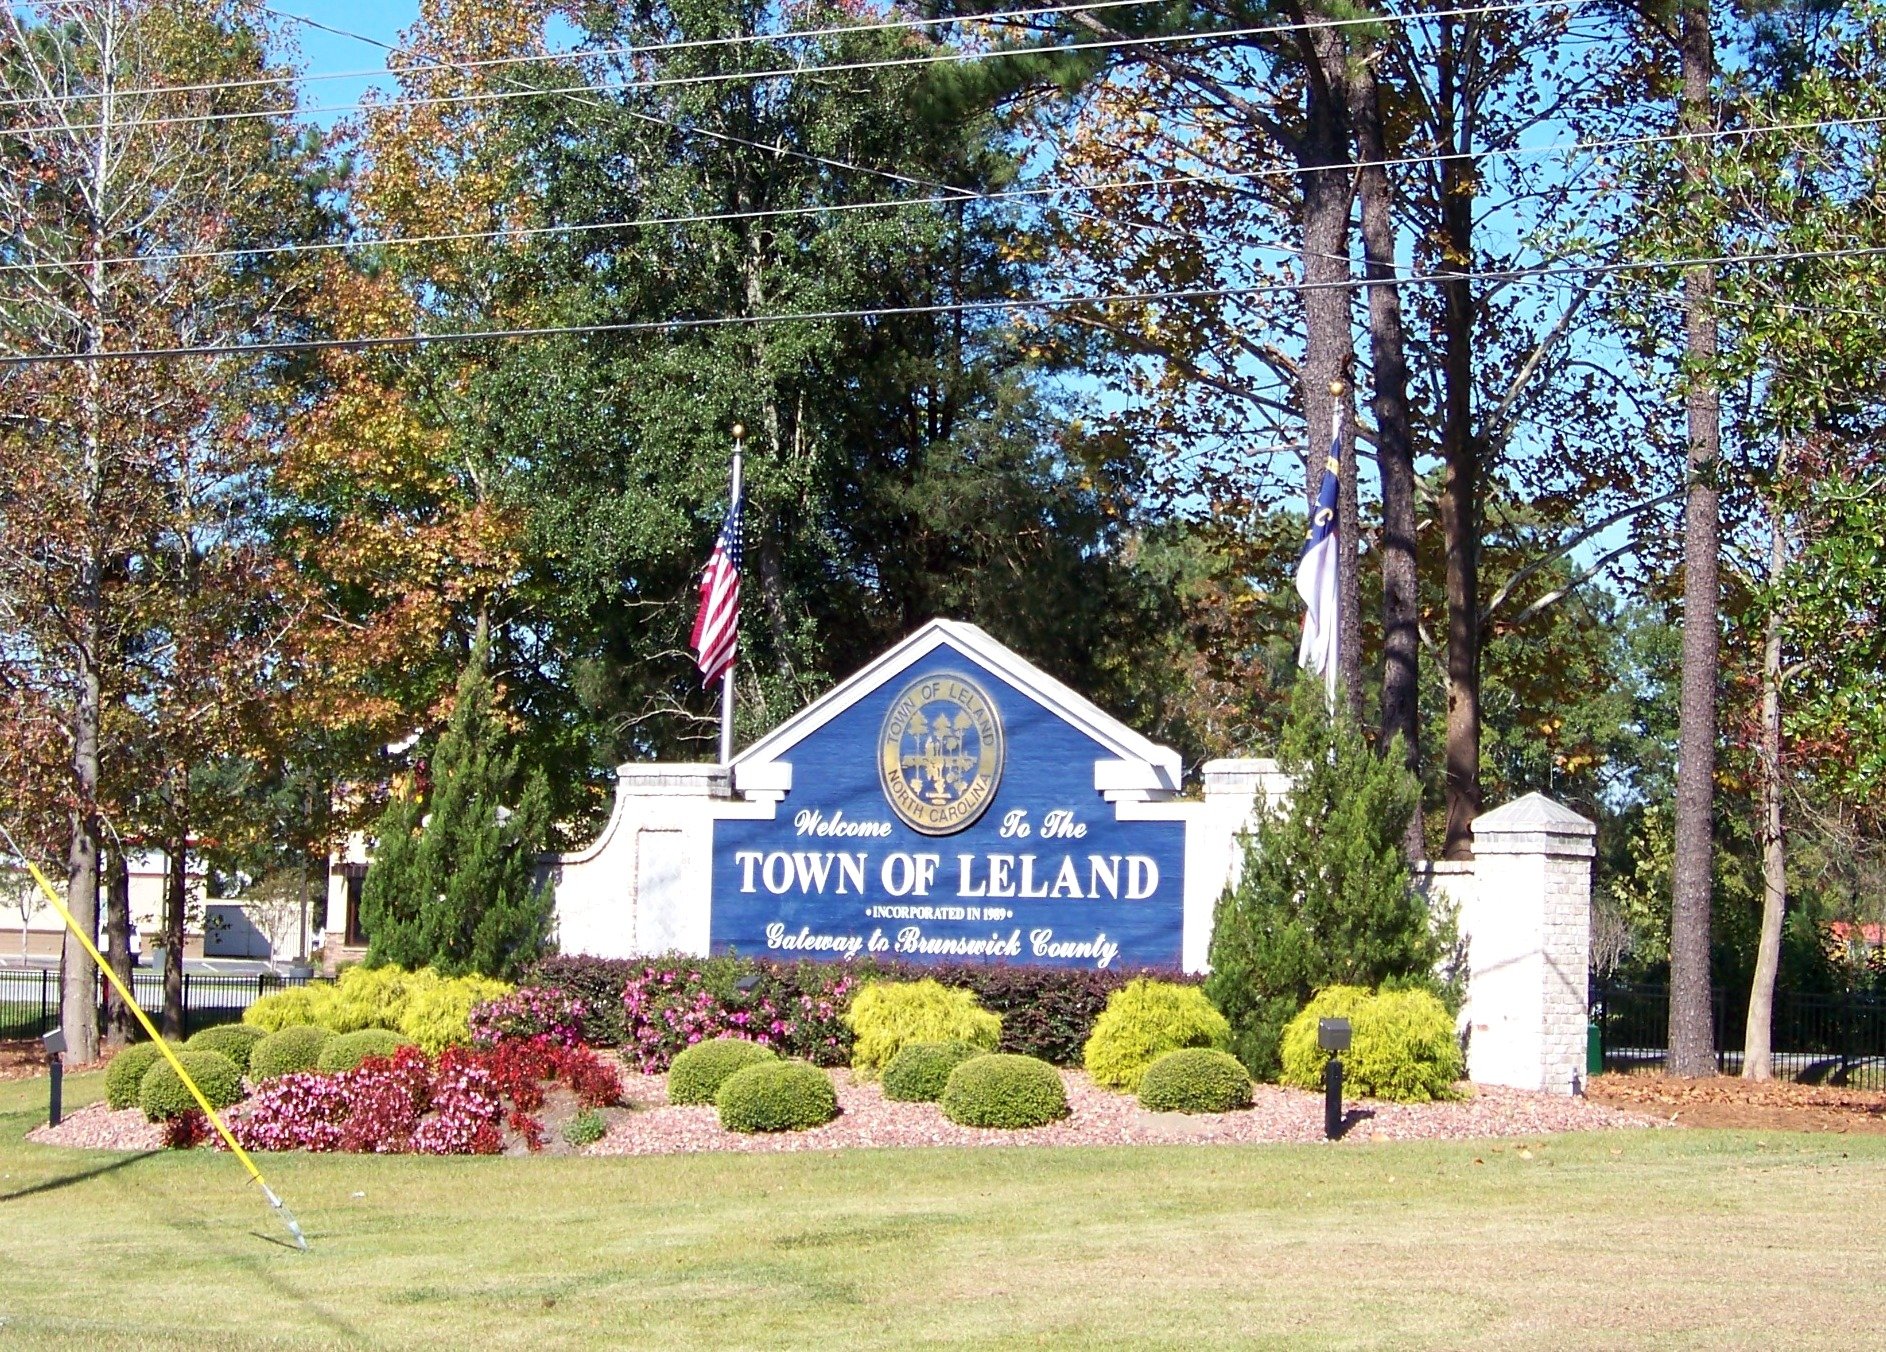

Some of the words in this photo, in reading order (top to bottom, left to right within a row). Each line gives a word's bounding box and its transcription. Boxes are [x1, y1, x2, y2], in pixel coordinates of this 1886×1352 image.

[887, 697, 916, 745] TOWN
[921, 682, 941, 700] OF
[949, 683, 995, 747] LELAND
[888, 769, 924, 819] NORTH
[929, 773, 991, 823] CAROLINA
[794, 809, 892, 838] Welcome
[1000, 809, 1031, 839] To
[1040, 809, 1087, 839] The
[735, 852, 868, 895] TOWN
[881, 853, 940, 896] OF
[956, 854, 1160, 900] LELAND
[966, 907, 981, 921] IN
[766, 922, 863, 962] Gateway
[867, 928, 890, 952] to
[894, 926, 1022, 957] Brunswick
[1029, 928, 1119, 969] County
